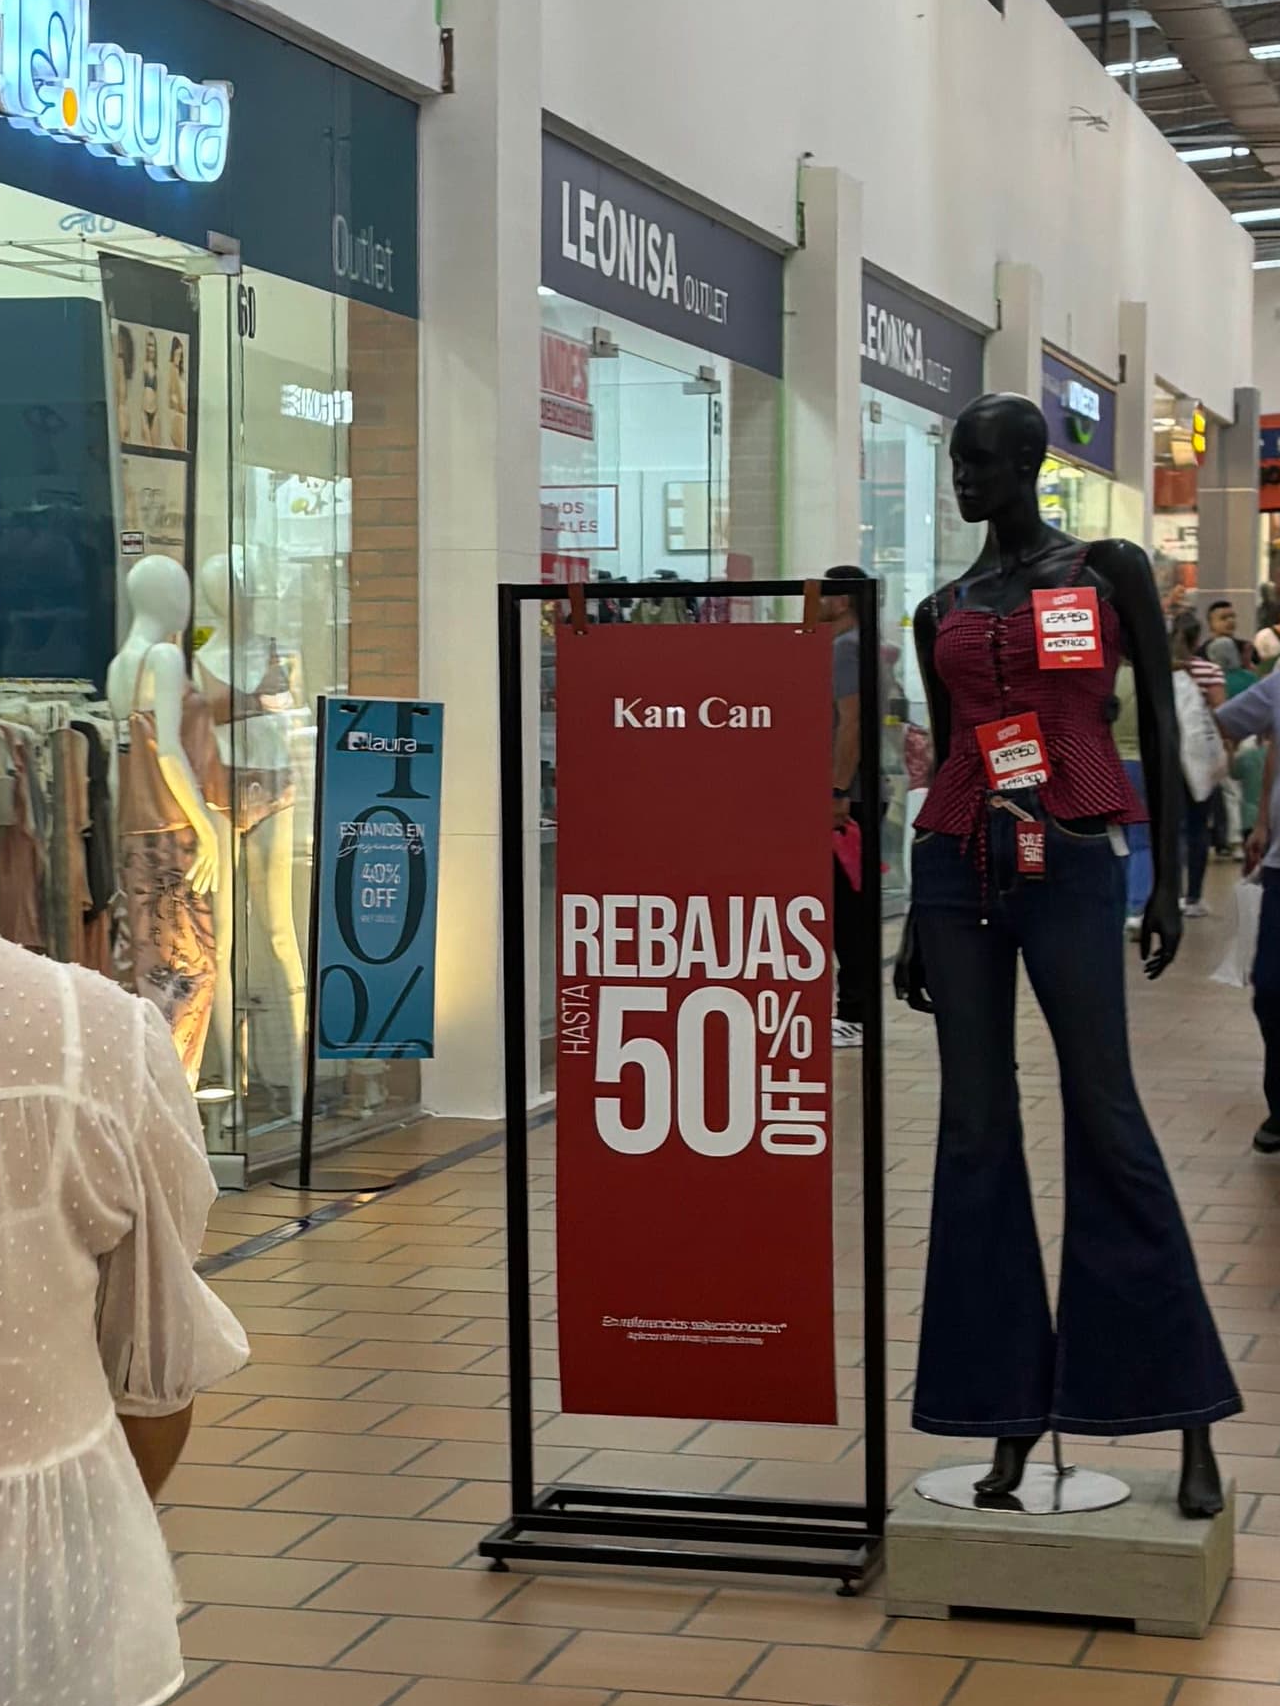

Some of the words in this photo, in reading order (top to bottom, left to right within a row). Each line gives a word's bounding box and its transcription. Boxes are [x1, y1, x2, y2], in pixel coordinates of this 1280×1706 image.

[331, 214, 395, 293] Outlet
[561, 179, 679, 305] LEONISA
[859, 303, 925, 382] EONISA
[367, 732, 417, 753] laura
[613, 697, 686, 728] Kan
[698, 696, 772, 729] Can
[339, 821, 403, 838] ESTAMOS
[406, 822, 425, 838] EN
[361, 863, 401, 885] 40%
[361, 888, 398, 908] OFF
[562, 894, 826, 982] REBAJAS
[561, 984, 591, 1054] HASTA
[594, 986, 813, 1157] 50%
[760, 1064, 827, 1156] OFF
